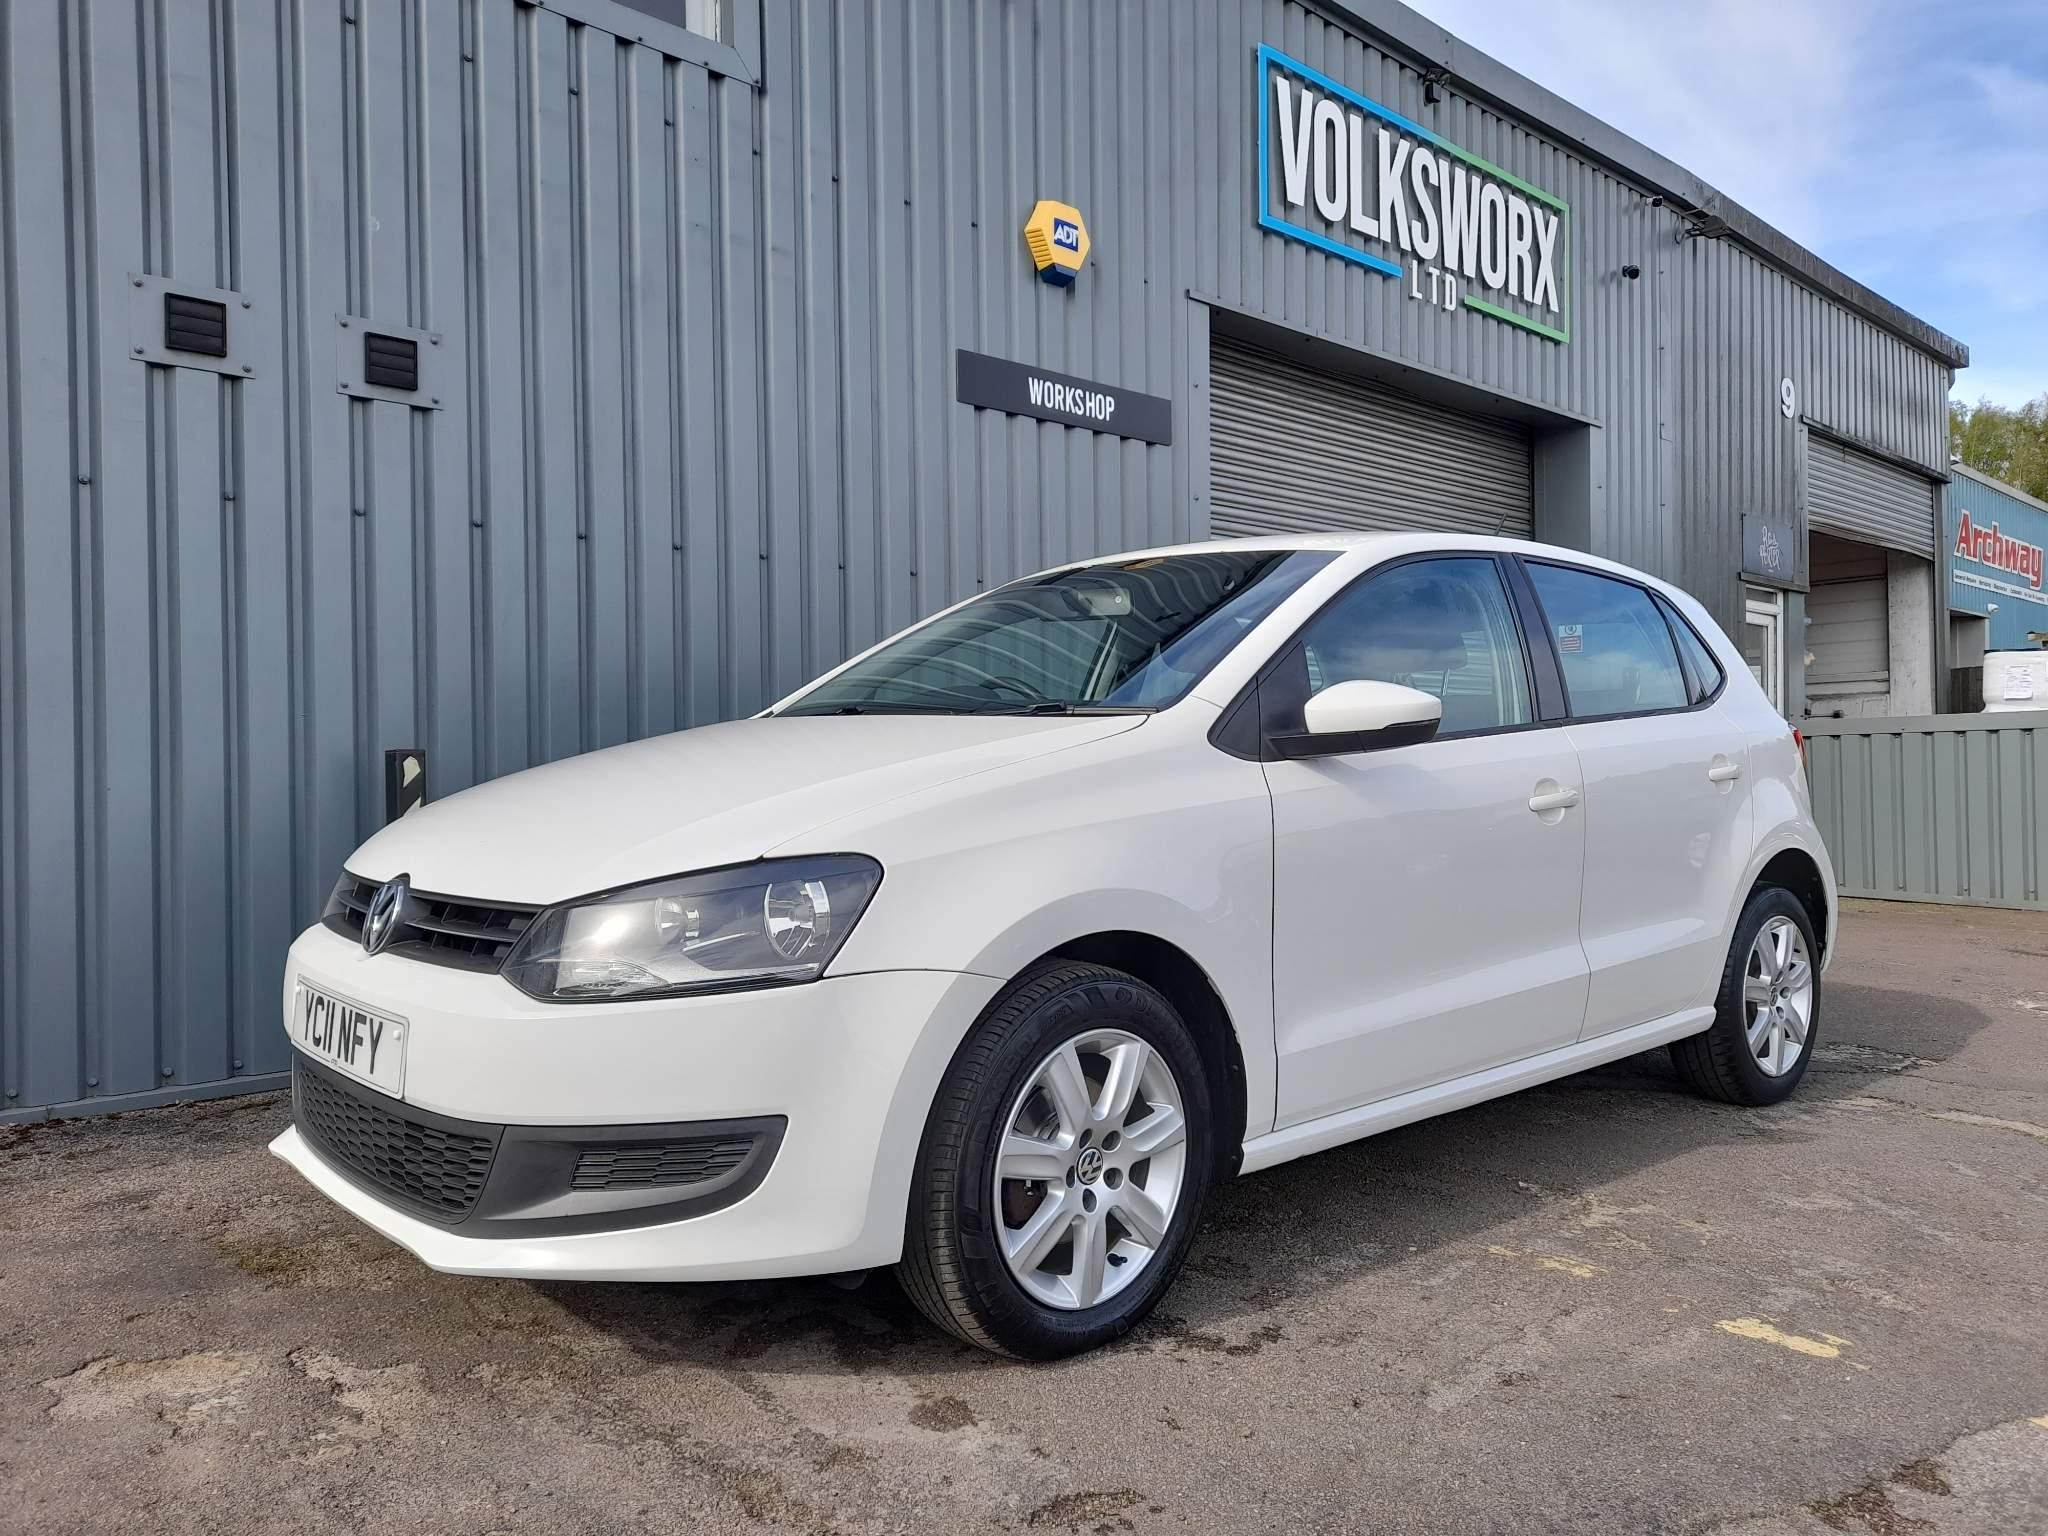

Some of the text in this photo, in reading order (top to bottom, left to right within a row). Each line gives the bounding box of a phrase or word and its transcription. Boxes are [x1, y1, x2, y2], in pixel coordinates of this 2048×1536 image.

[1276, 76, 1559, 313] VOLKSWORX
[1054, 222, 1079, 248] ADT
[1409, 259, 1457, 312] LTD
[1028, 376, 1115, 421] WORKSHOP
[1781, 377, 1796, 419] 9
[1955, 510, 2043, 589] Archway
[304, 989, 383, 1075] YC11 NFY
